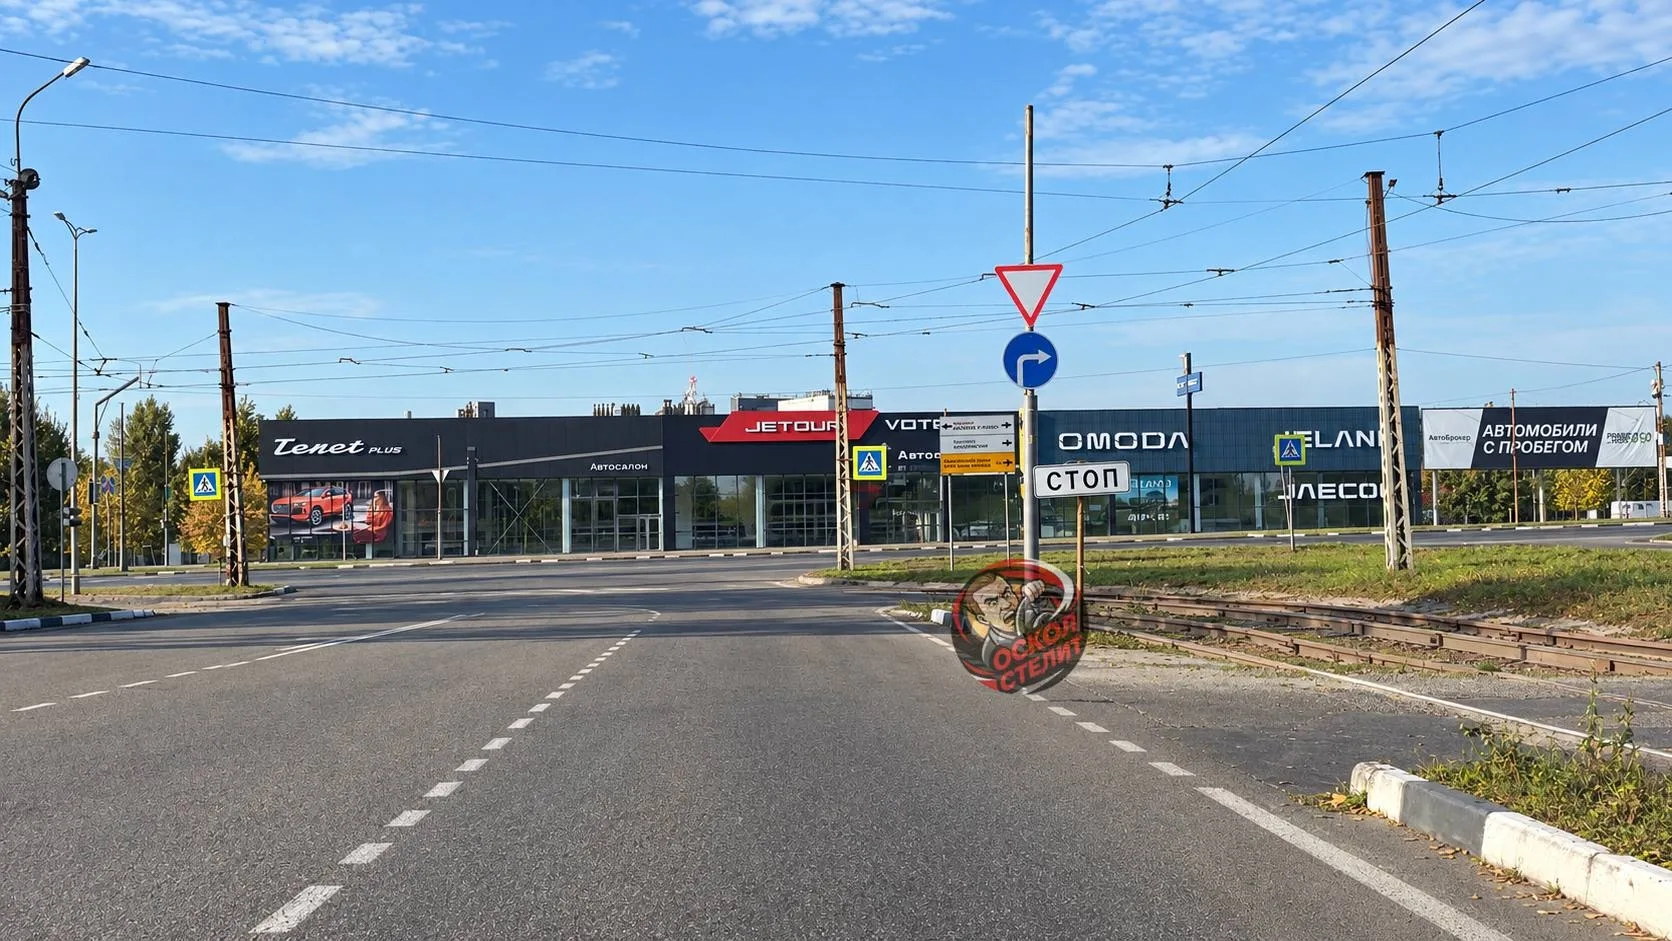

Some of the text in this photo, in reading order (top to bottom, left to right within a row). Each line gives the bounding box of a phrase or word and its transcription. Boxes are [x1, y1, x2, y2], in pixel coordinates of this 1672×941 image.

[1482, 424, 1597, 438] АВТОМОБИЛИ
[273, 438, 402, 456] Tenet PLUS
[1058, 432, 1189, 450] OMODA
[1483, 440, 1588, 454] С ПРОБЕГОМ
[590, 462, 648, 471] Автосалон
[1046, 468, 1118, 491] СТОП
